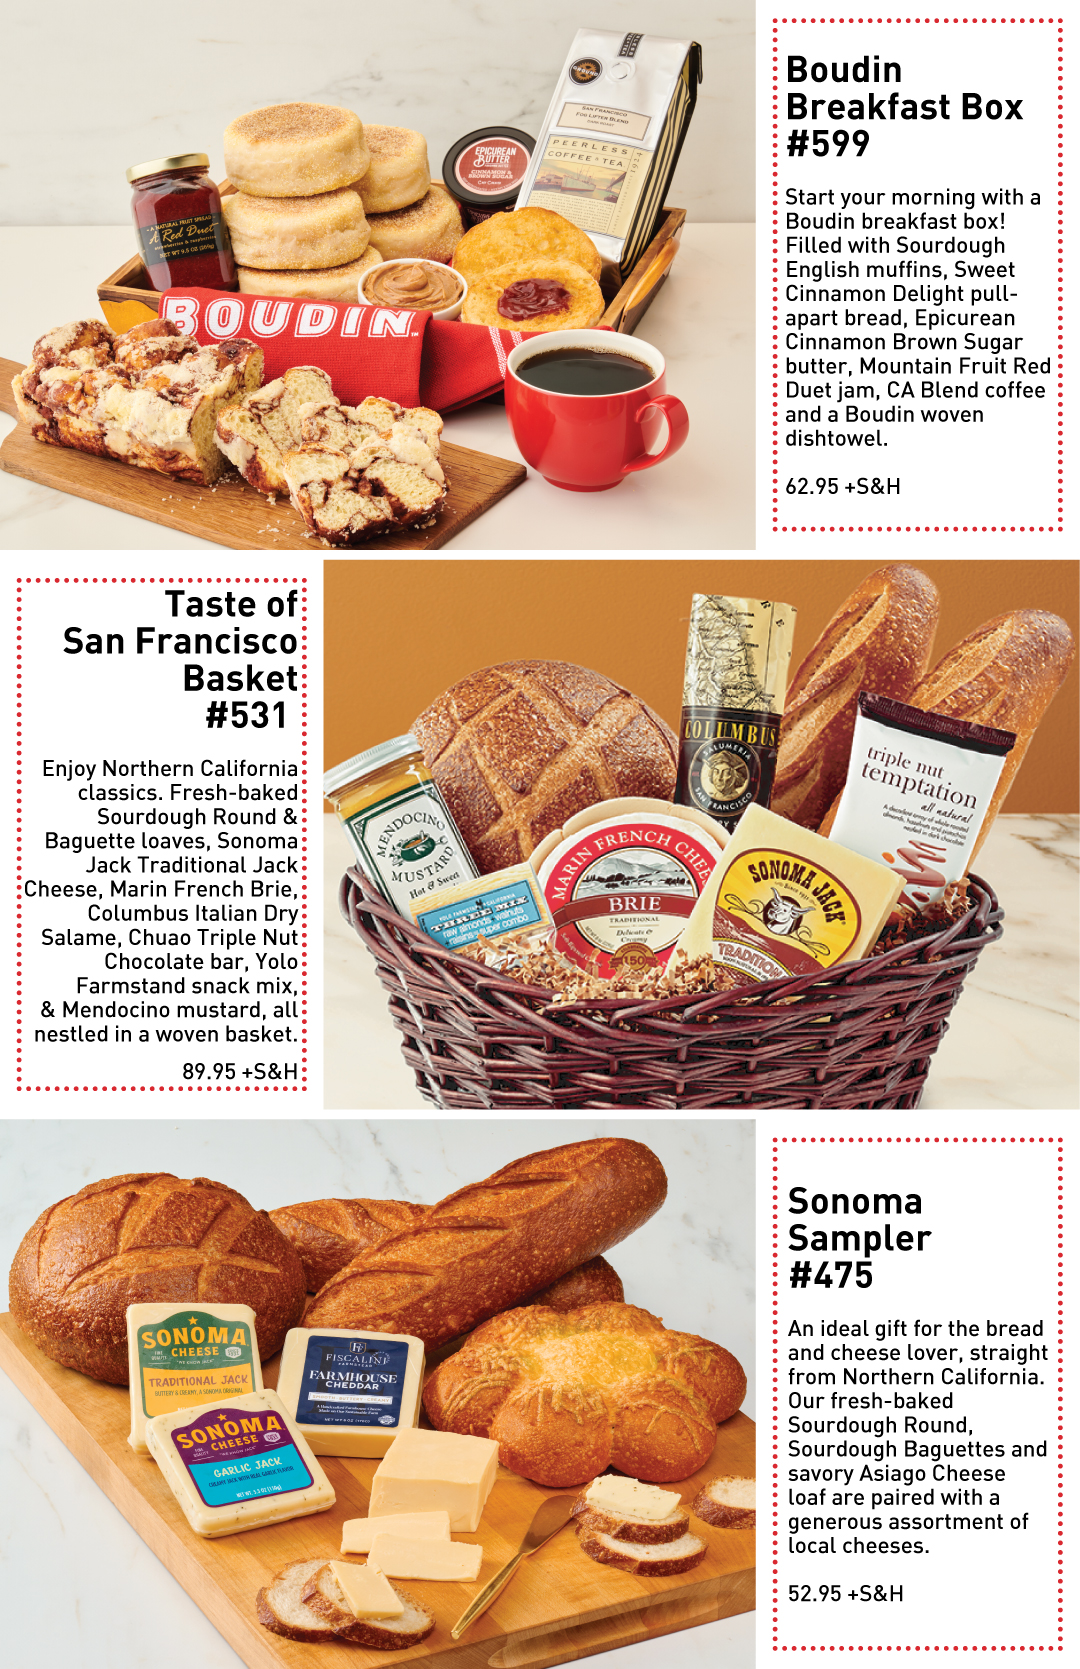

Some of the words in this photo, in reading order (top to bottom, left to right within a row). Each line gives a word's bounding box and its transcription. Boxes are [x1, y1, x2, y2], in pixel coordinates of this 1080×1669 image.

[572, 65, 599, 77] GROUND
[475, 146, 517, 156] EPICUREAN
[548, 150, 592, 161] COFFEE
[552, 140, 628, 155] PEERLESS
[630, 152, 644, 173] 1924
[149, 231, 160, 244] A
[162, 226, 184, 242] Red
[186, 222, 219, 236] Duet
[684, 720, 776, 746] COLUMBUS
[702, 742, 752, 760] SALUMERIA
[867, 746, 912, 770] triple
[916, 762, 945, 780] nut
[861, 762, 978, 810] temptation
[694, 786, 708, 802] SAN
[708, 792, 752, 810] FRANCISCO
[920, 802, 937, 813] all
[936, 808, 974, 824] natural
[376, 812, 446, 858] MENDOCINO
[392, 846, 454, 883] MUSTARD
[552, 846, 593, 900] MARIN
[593, 830, 672, 850] FRENCH
[409, 887, 426, 900] Hot
[436, 872, 460, 886] Sweet
[748, 860, 818, 890] SONOMA
[812, 882, 846, 923] JACK
[430, 907, 494, 934] THREE
[494, 895, 530, 913] MIX
[608, 896, 662, 912] BRIE
[479, 923, 500, 938] super
[501, 914, 530, 928] combo
[609, 916, 660, 924] TRADITIONAL
[442, 928, 458, 938] raw
[616, 928, 646, 936] Delicate
[624, 956, 646, 965] 150
[141, 1326, 247, 1350] SONOMA
[171, 1346, 220, 1358] CHEESE
[326, 1354, 388, 1365] FISCALINI
[148, 1376, 218, 1388] TRADITIONAL
[220, 1374, 249, 1385] JACK
[309, 1370, 398, 1384] FARMHOUSE
[325, 1380, 380, 1391] CHEDDAR
[176, 1416, 283, 1449] SONOMA
[210, 1434, 259, 1452] CHEESE
[214, 1463, 252, 1478] GARLIC
[255, 1456, 283, 1470] JACK
